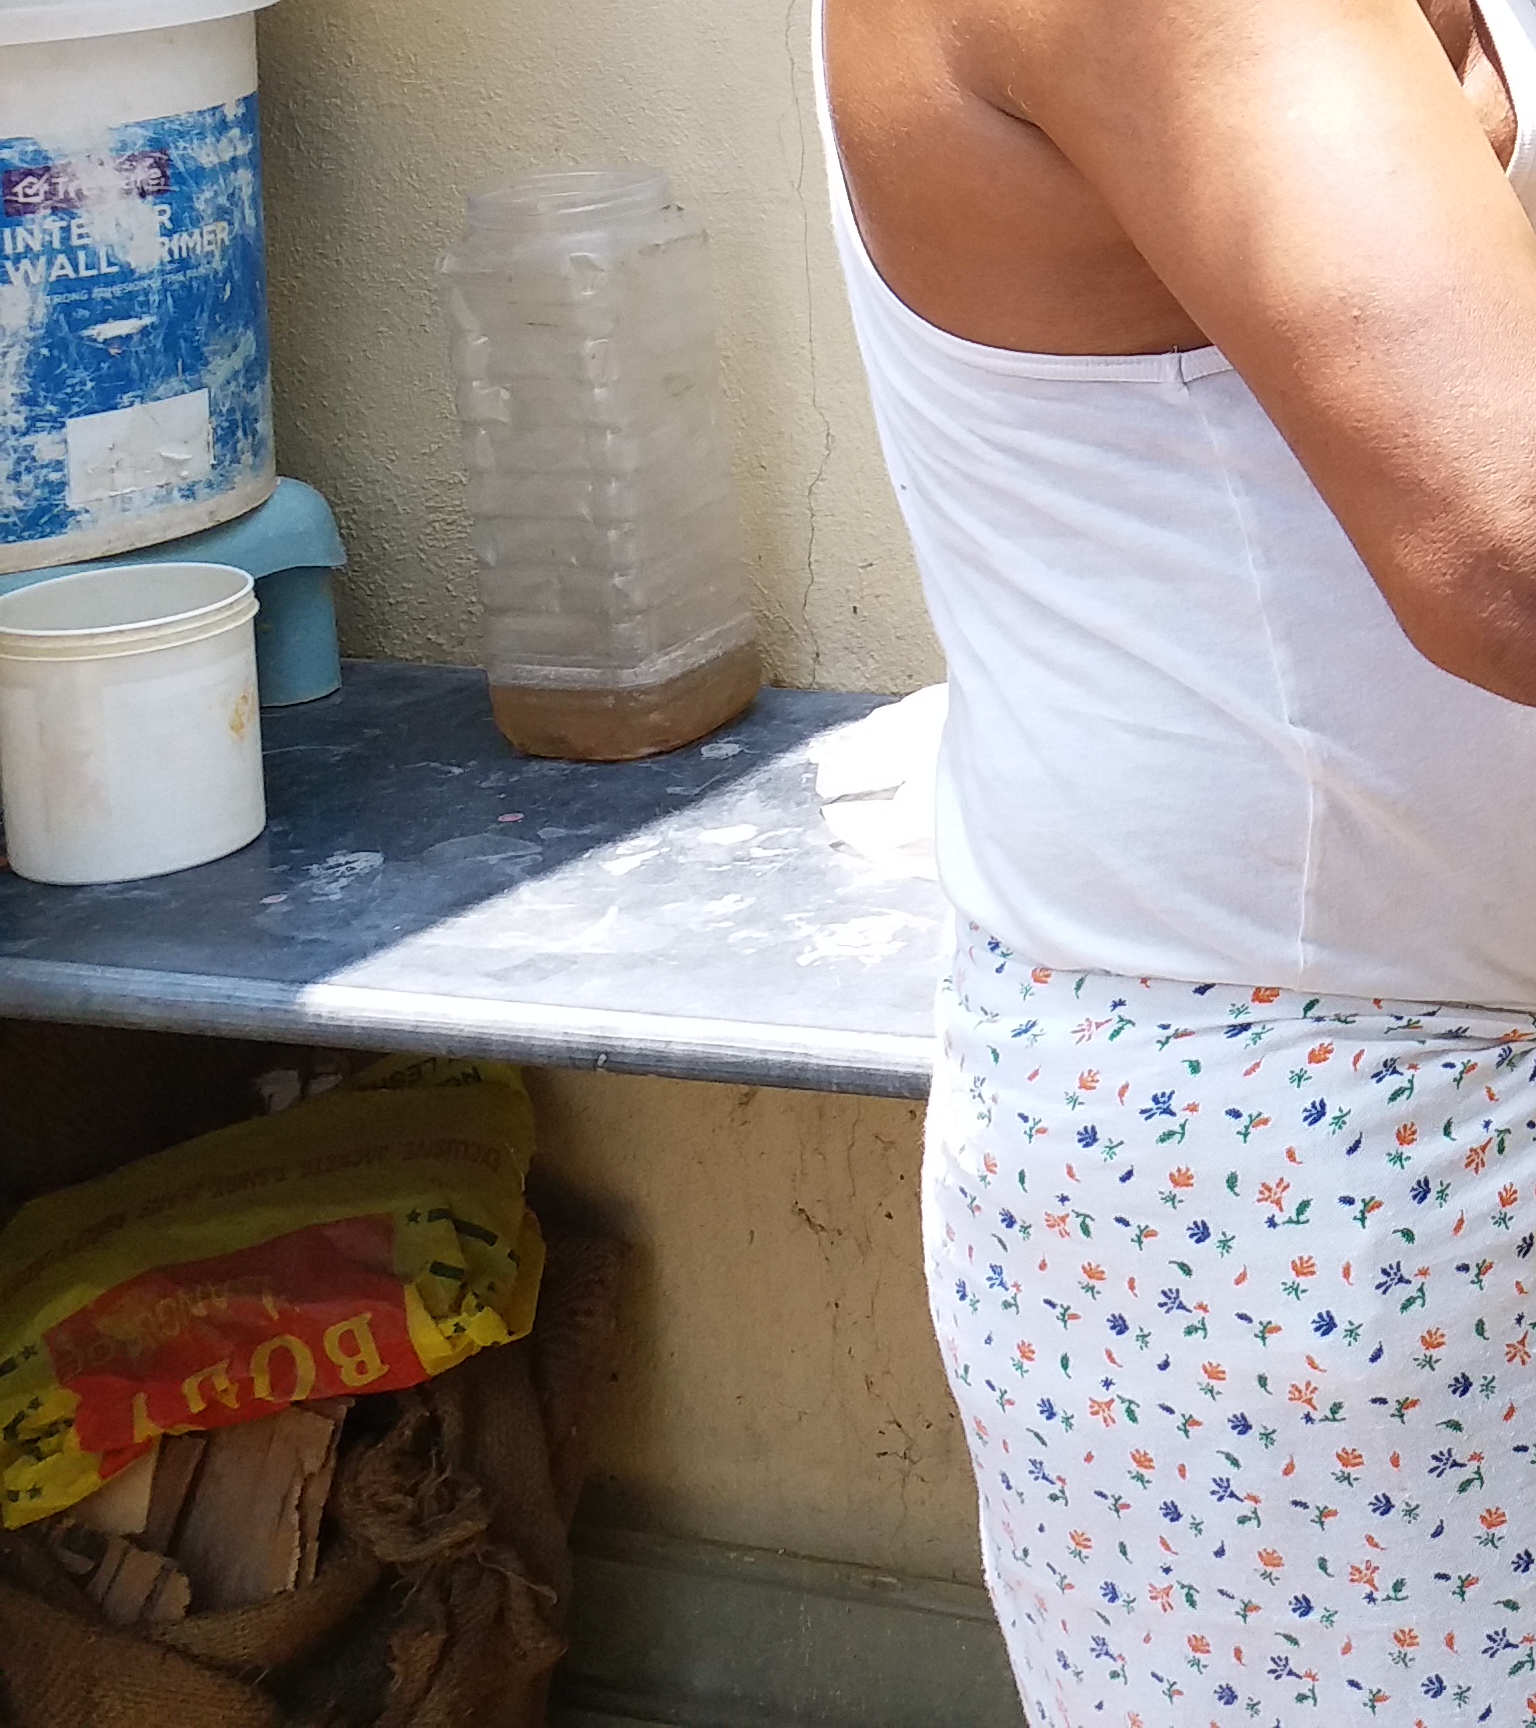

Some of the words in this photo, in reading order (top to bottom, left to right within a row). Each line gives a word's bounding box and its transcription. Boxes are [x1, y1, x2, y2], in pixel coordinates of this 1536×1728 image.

[3, 203, 173, 256] INTER
[4, 246, 120, 287] WALL
[156, 221, 230, 262] RIMER
